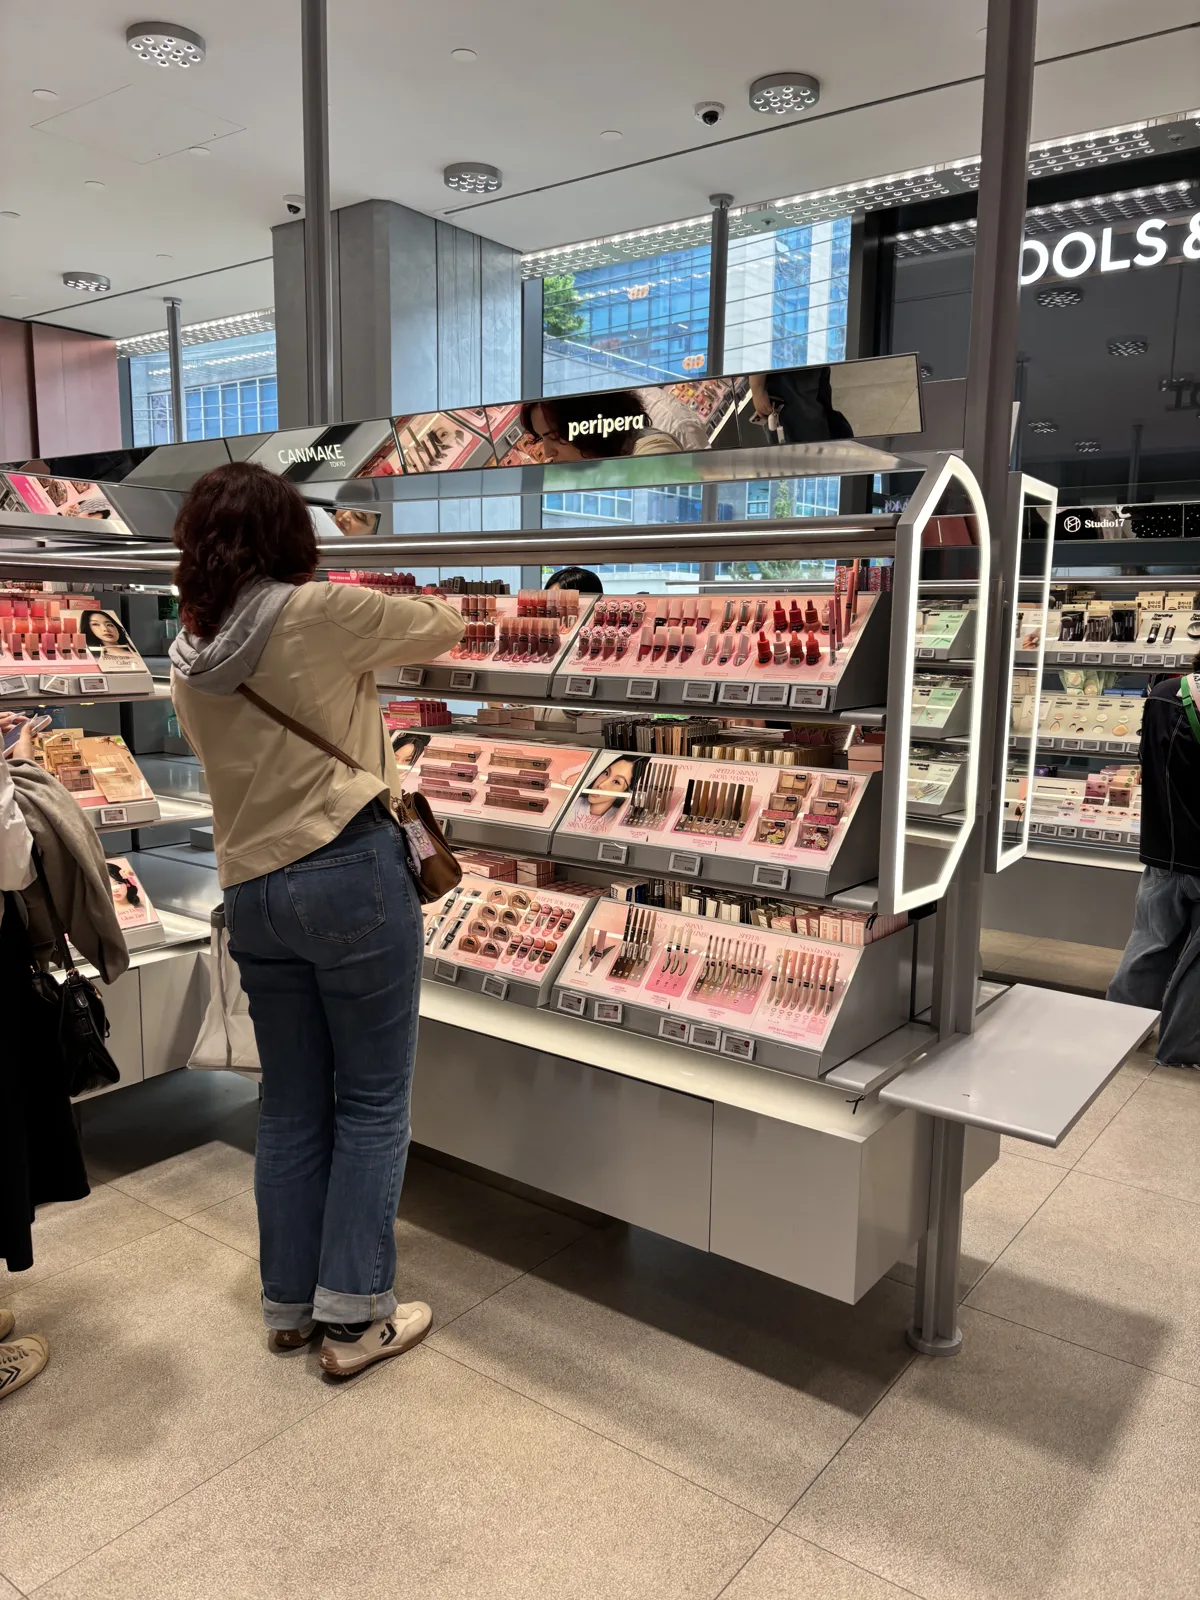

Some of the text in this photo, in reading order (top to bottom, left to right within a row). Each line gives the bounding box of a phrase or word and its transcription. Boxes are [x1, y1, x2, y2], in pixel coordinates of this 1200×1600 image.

[568, 413, 644, 442] peripera
[277, 444, 344, 464] CANMAKE
[329, 460, 346, 468] TOKYO
[1084, 518, 1125, 529] Studio17
